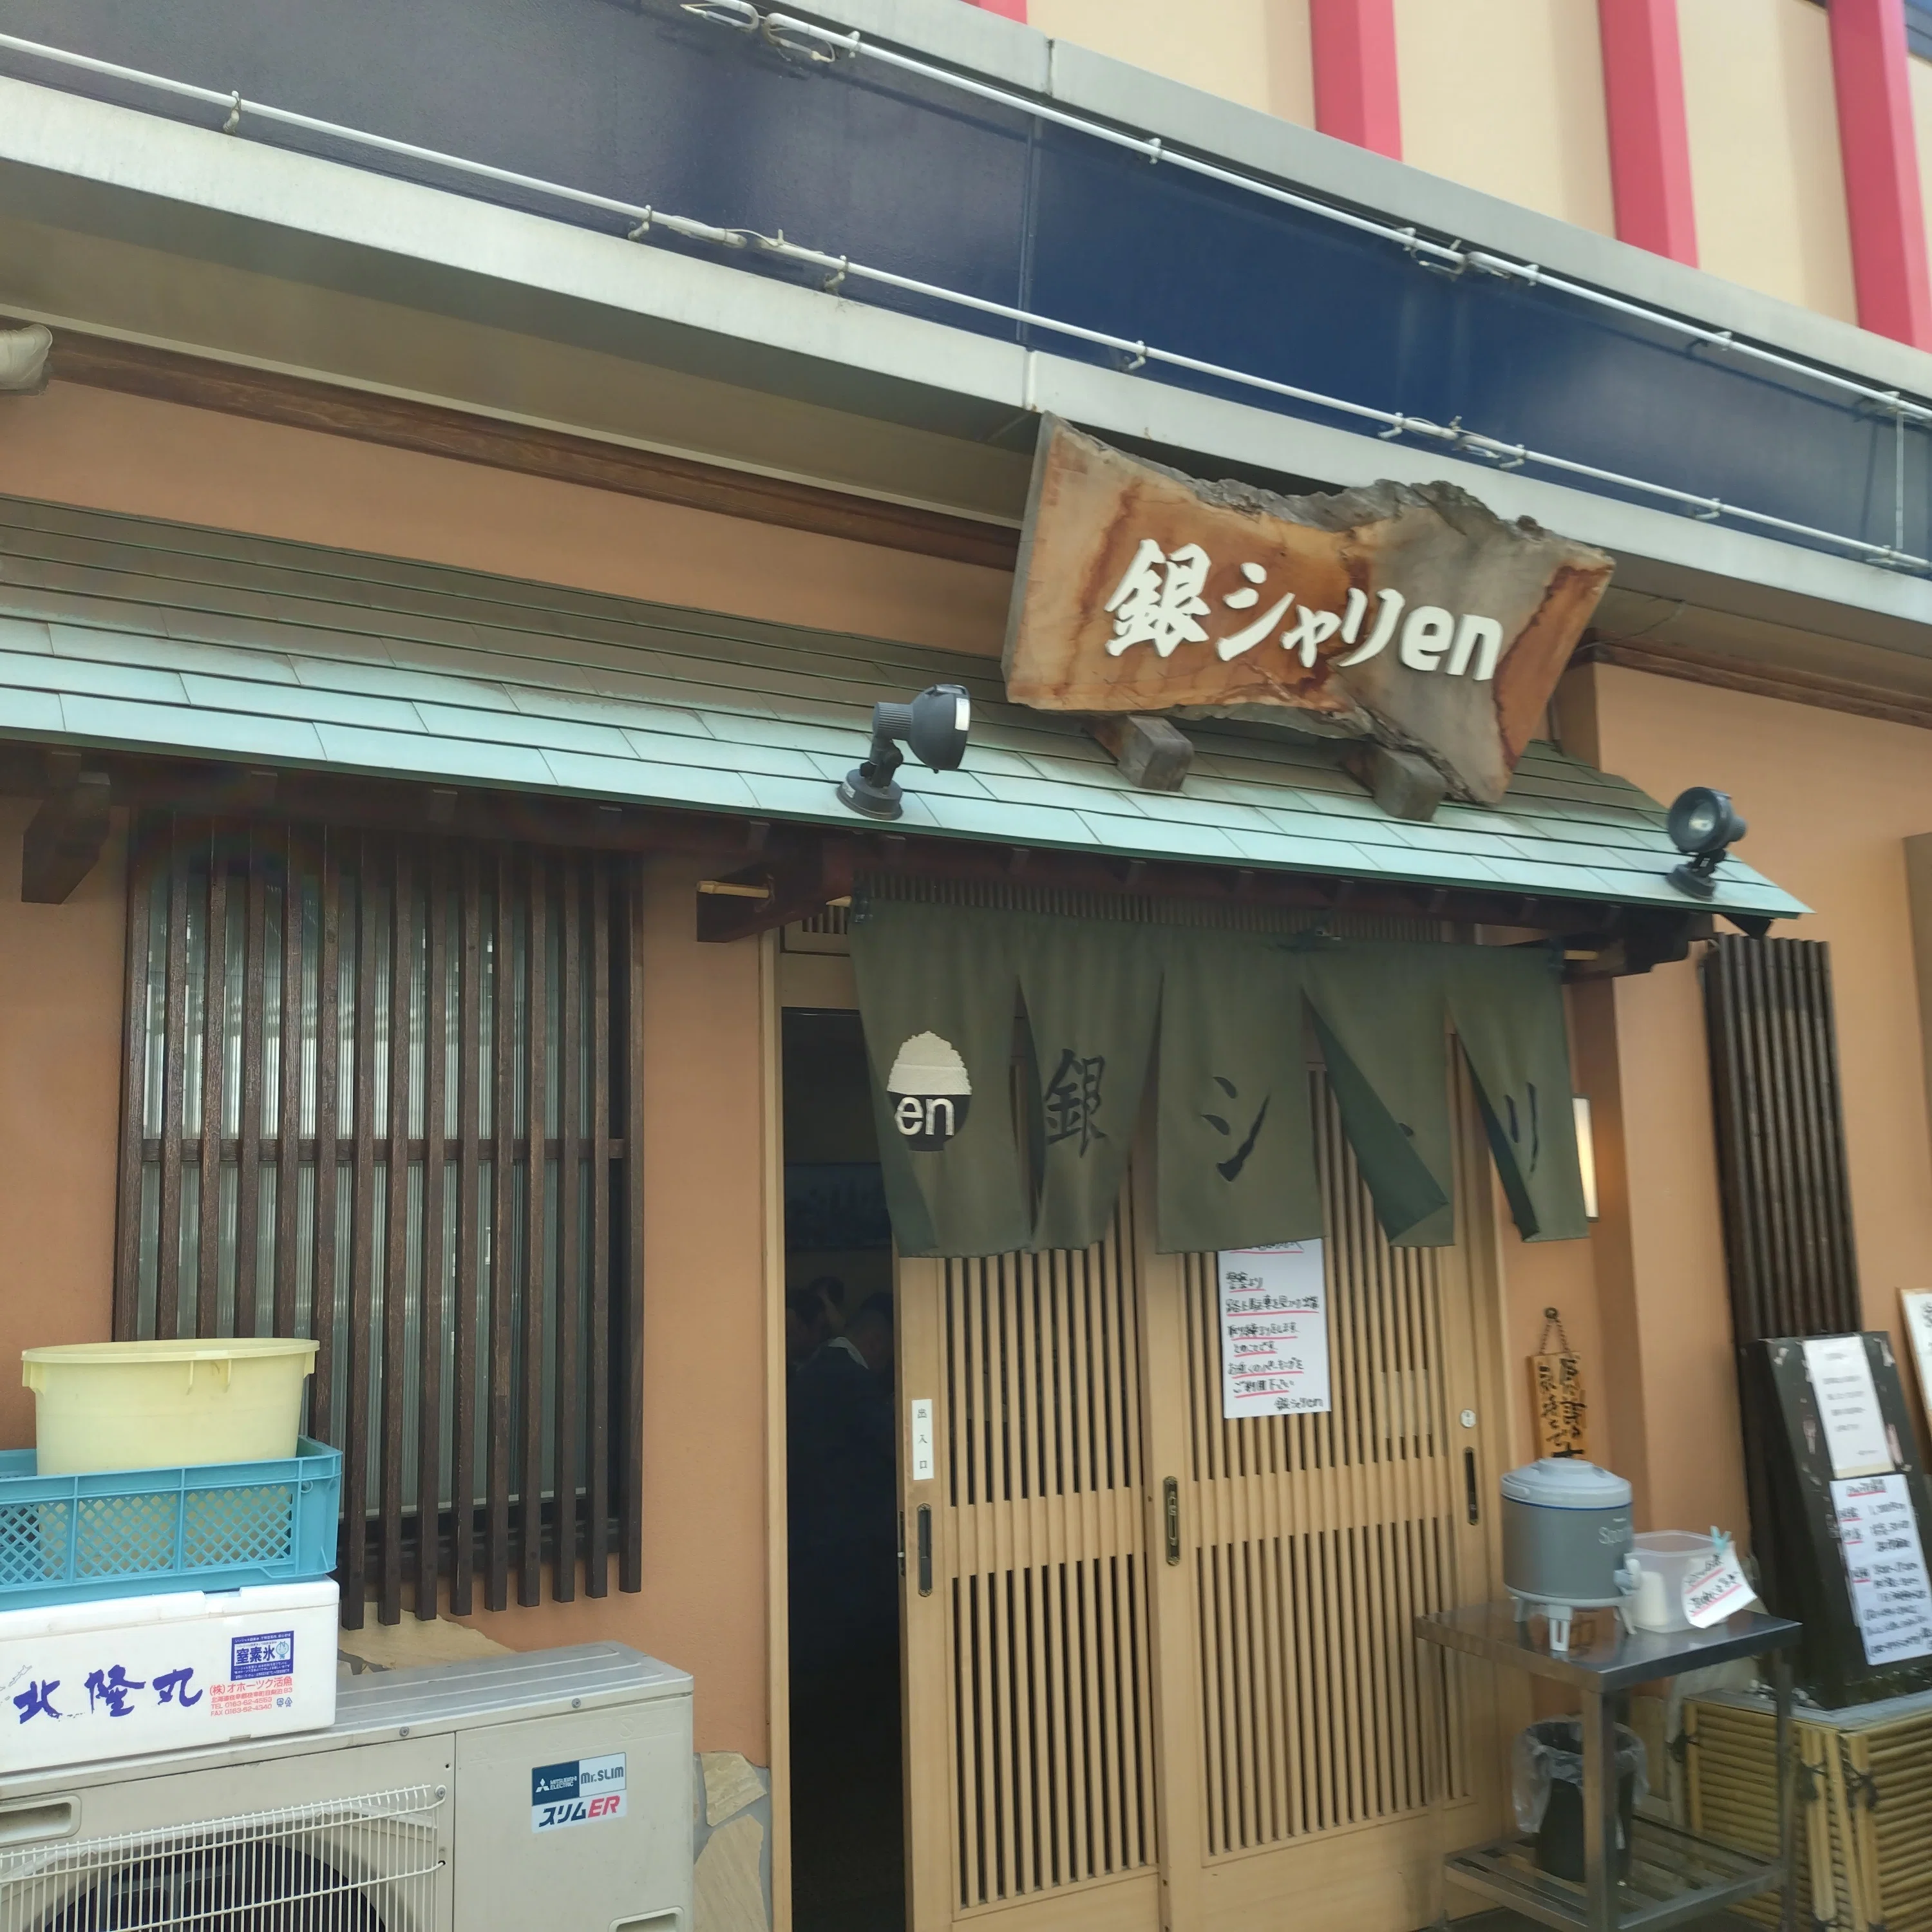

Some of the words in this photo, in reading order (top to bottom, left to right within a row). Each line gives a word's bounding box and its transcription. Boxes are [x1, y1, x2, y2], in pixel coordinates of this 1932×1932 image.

[1104, 538, 1502, 681] 銀シャリen
[894, 1097, 955, 1136] en
[917, 1408, 928, 1470] 出入口
[236, 1645, 276, 1665] 窒素氷
[550, 1776, 577, 1786] MITSUBISHI
[550, 1782, 574, 1790] ELECTRIC
